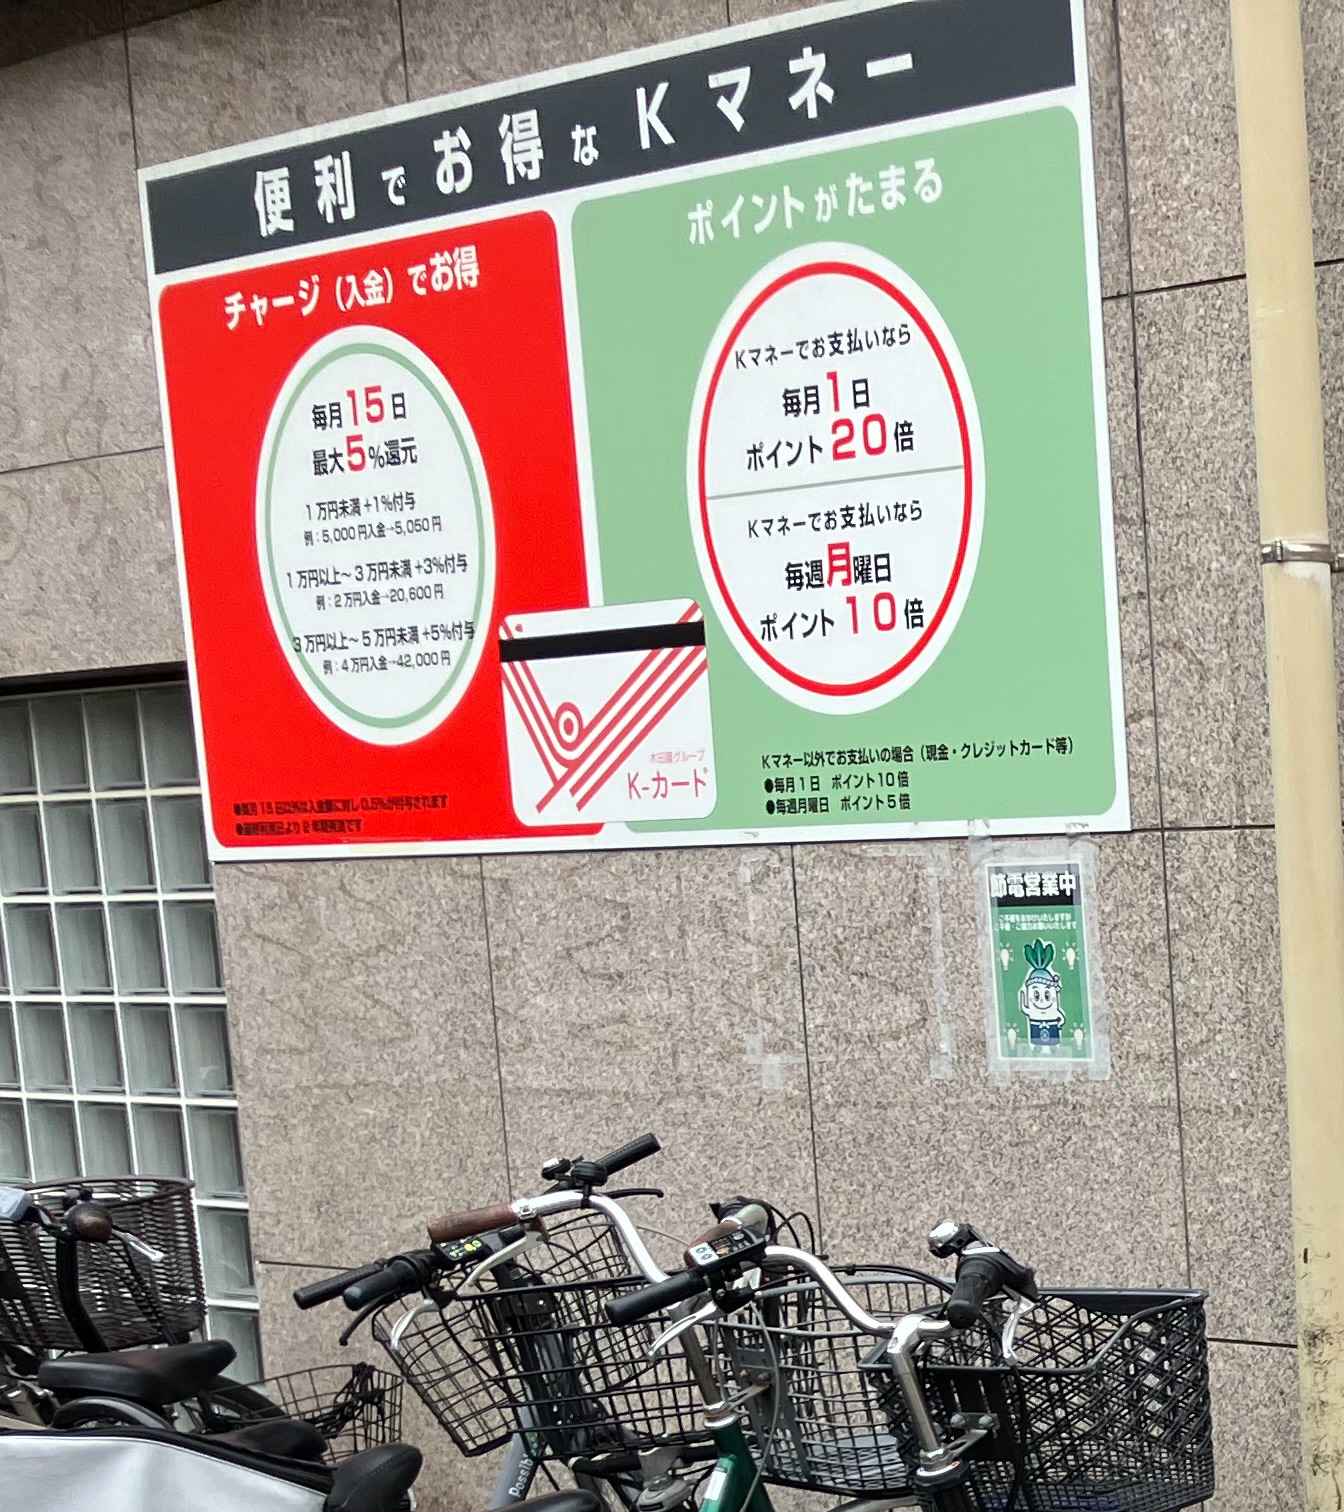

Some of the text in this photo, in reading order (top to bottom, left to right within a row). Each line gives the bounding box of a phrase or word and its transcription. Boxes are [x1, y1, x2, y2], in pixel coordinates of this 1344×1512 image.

[254, 48, 914, 238] 便利でお得なKマネー
[687, 157, 944, 246] ポイントがたまる
[223, 246, 480, 332] チャージ（入金）でお得
[735, 323, 912, 369] Kマネーでお支払いなら
[312, 385, 406, 431] 毎月15日
[781, 371, 871, 416] 毎月1日
[312, 434, 418, 476] 最大5%還元
[745, 413, 914, 472] ポイント20倍
[747, 501, 924, 539] Kマネーでお支払いなら
[784, 541, 893, 591] 毎週月曜日
[759, 590, 925, 641] ポイント10倍
[627, 766, 708, 800] K-カード
[991, 870, 1077, 898] 節電営業中
